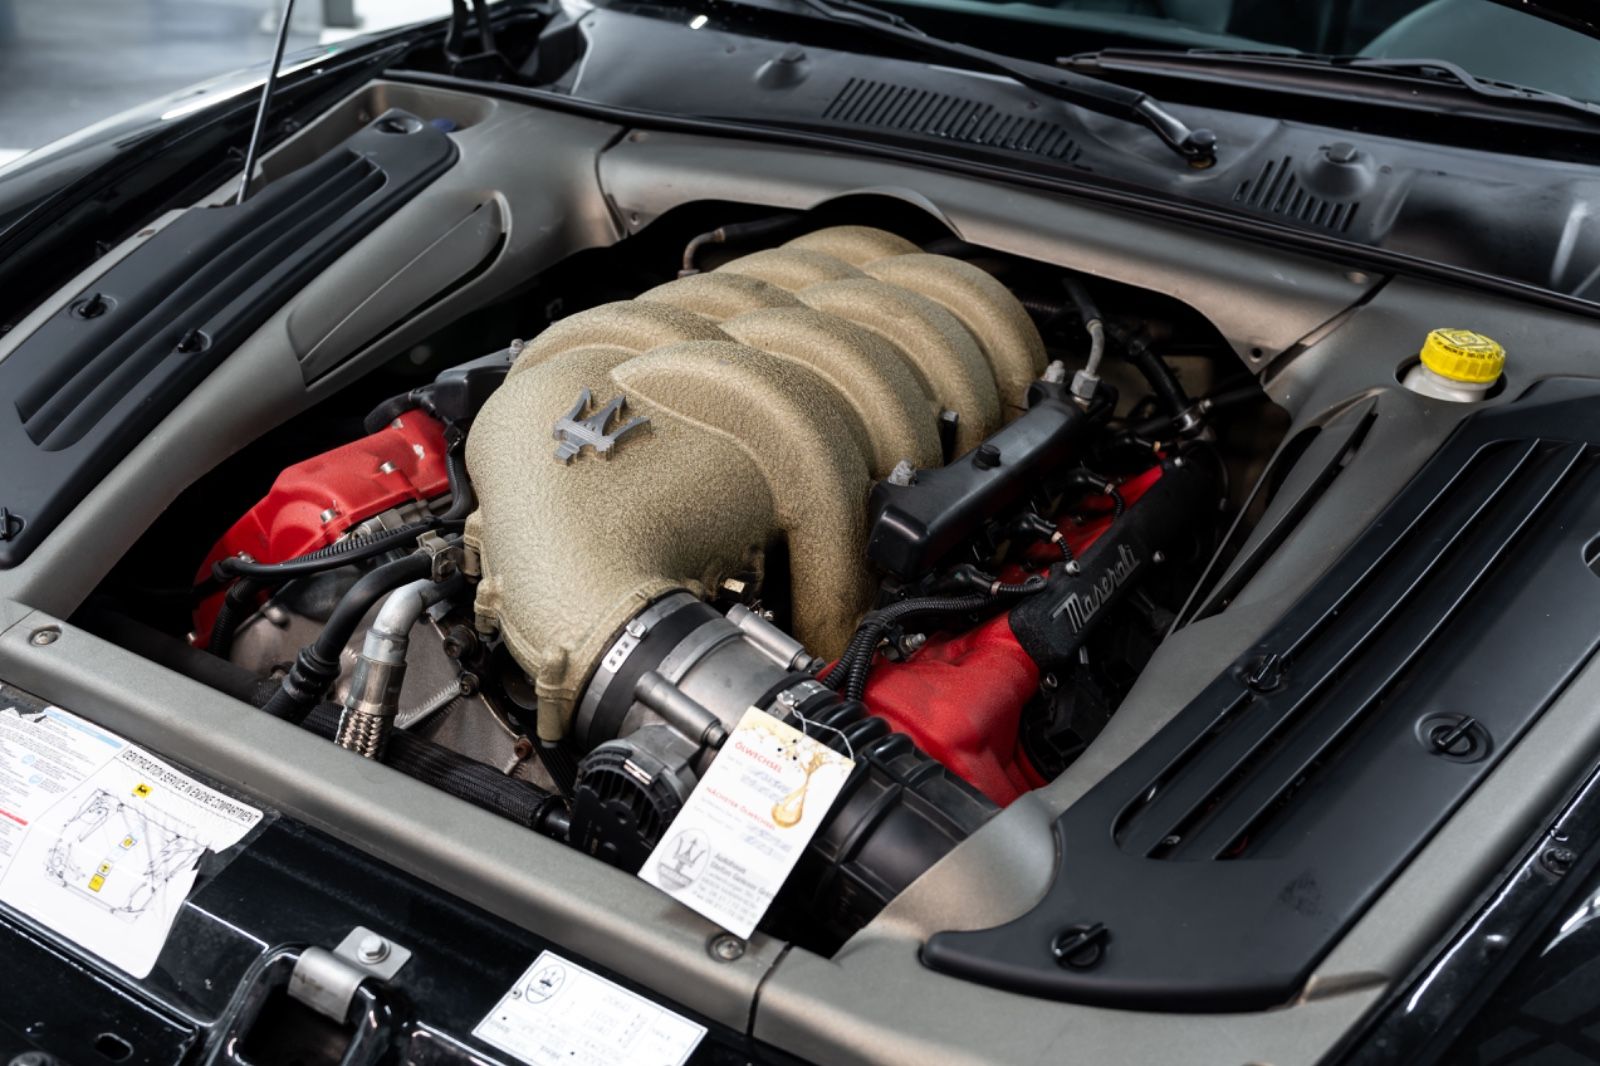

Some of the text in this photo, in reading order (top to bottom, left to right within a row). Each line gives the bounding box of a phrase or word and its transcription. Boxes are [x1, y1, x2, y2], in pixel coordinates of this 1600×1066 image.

[1052, 544, 1140, 633] Maserati
[735, 741, 782, 773] ÖLWECHSEL
[160, 772, 189, 790] SERVICE
[189, 787, 215, 804] ENGINE
[211, 798, 259, 823] COMPARTMENT
